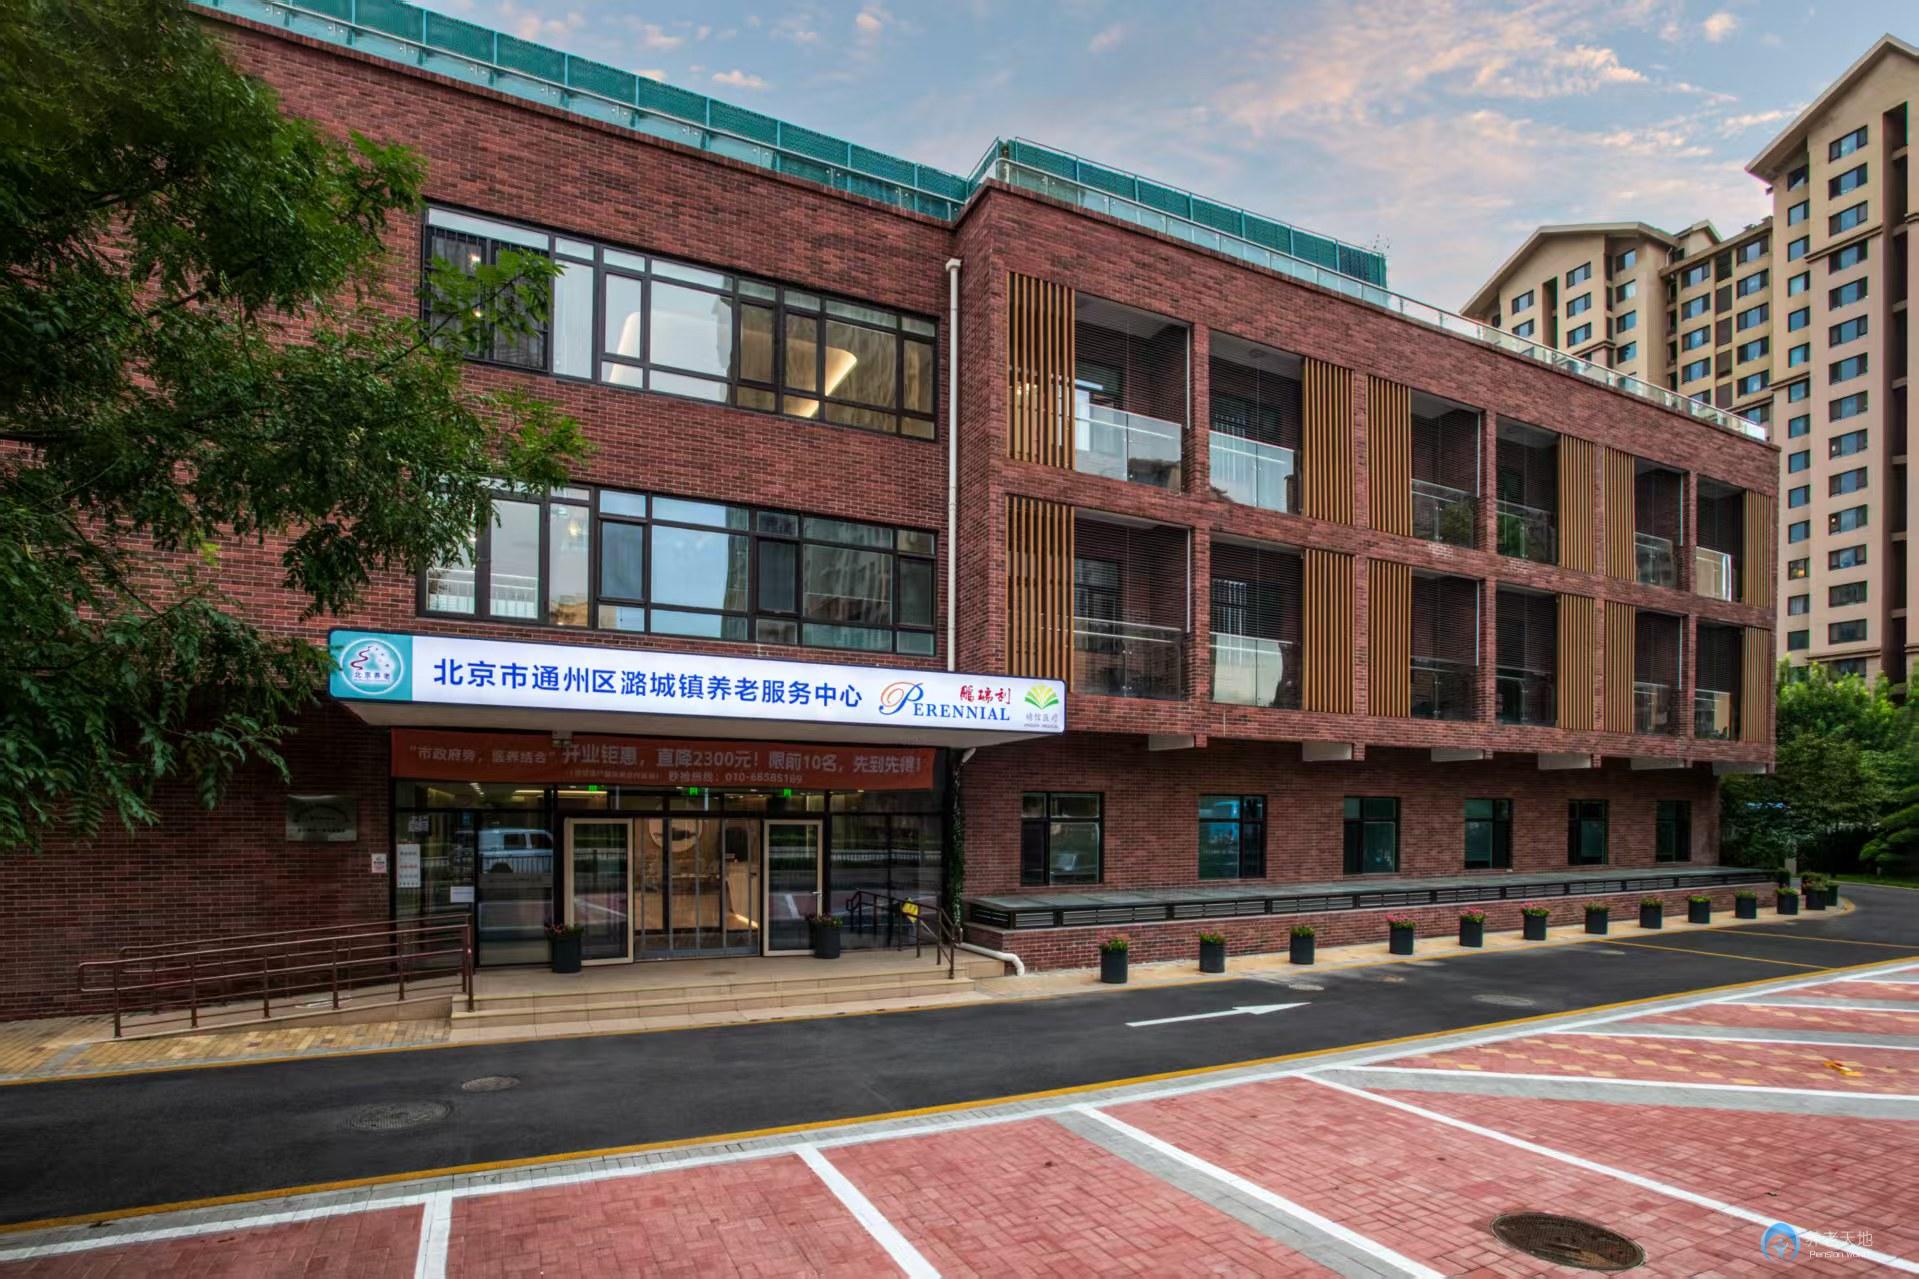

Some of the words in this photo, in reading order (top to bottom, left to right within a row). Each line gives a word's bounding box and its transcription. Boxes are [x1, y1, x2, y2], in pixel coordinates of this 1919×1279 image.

[433, 657, 863, 708] 北京市通州区潞城镇养老服务中心
[879, 681, 1011, 721] PERENNIAL
